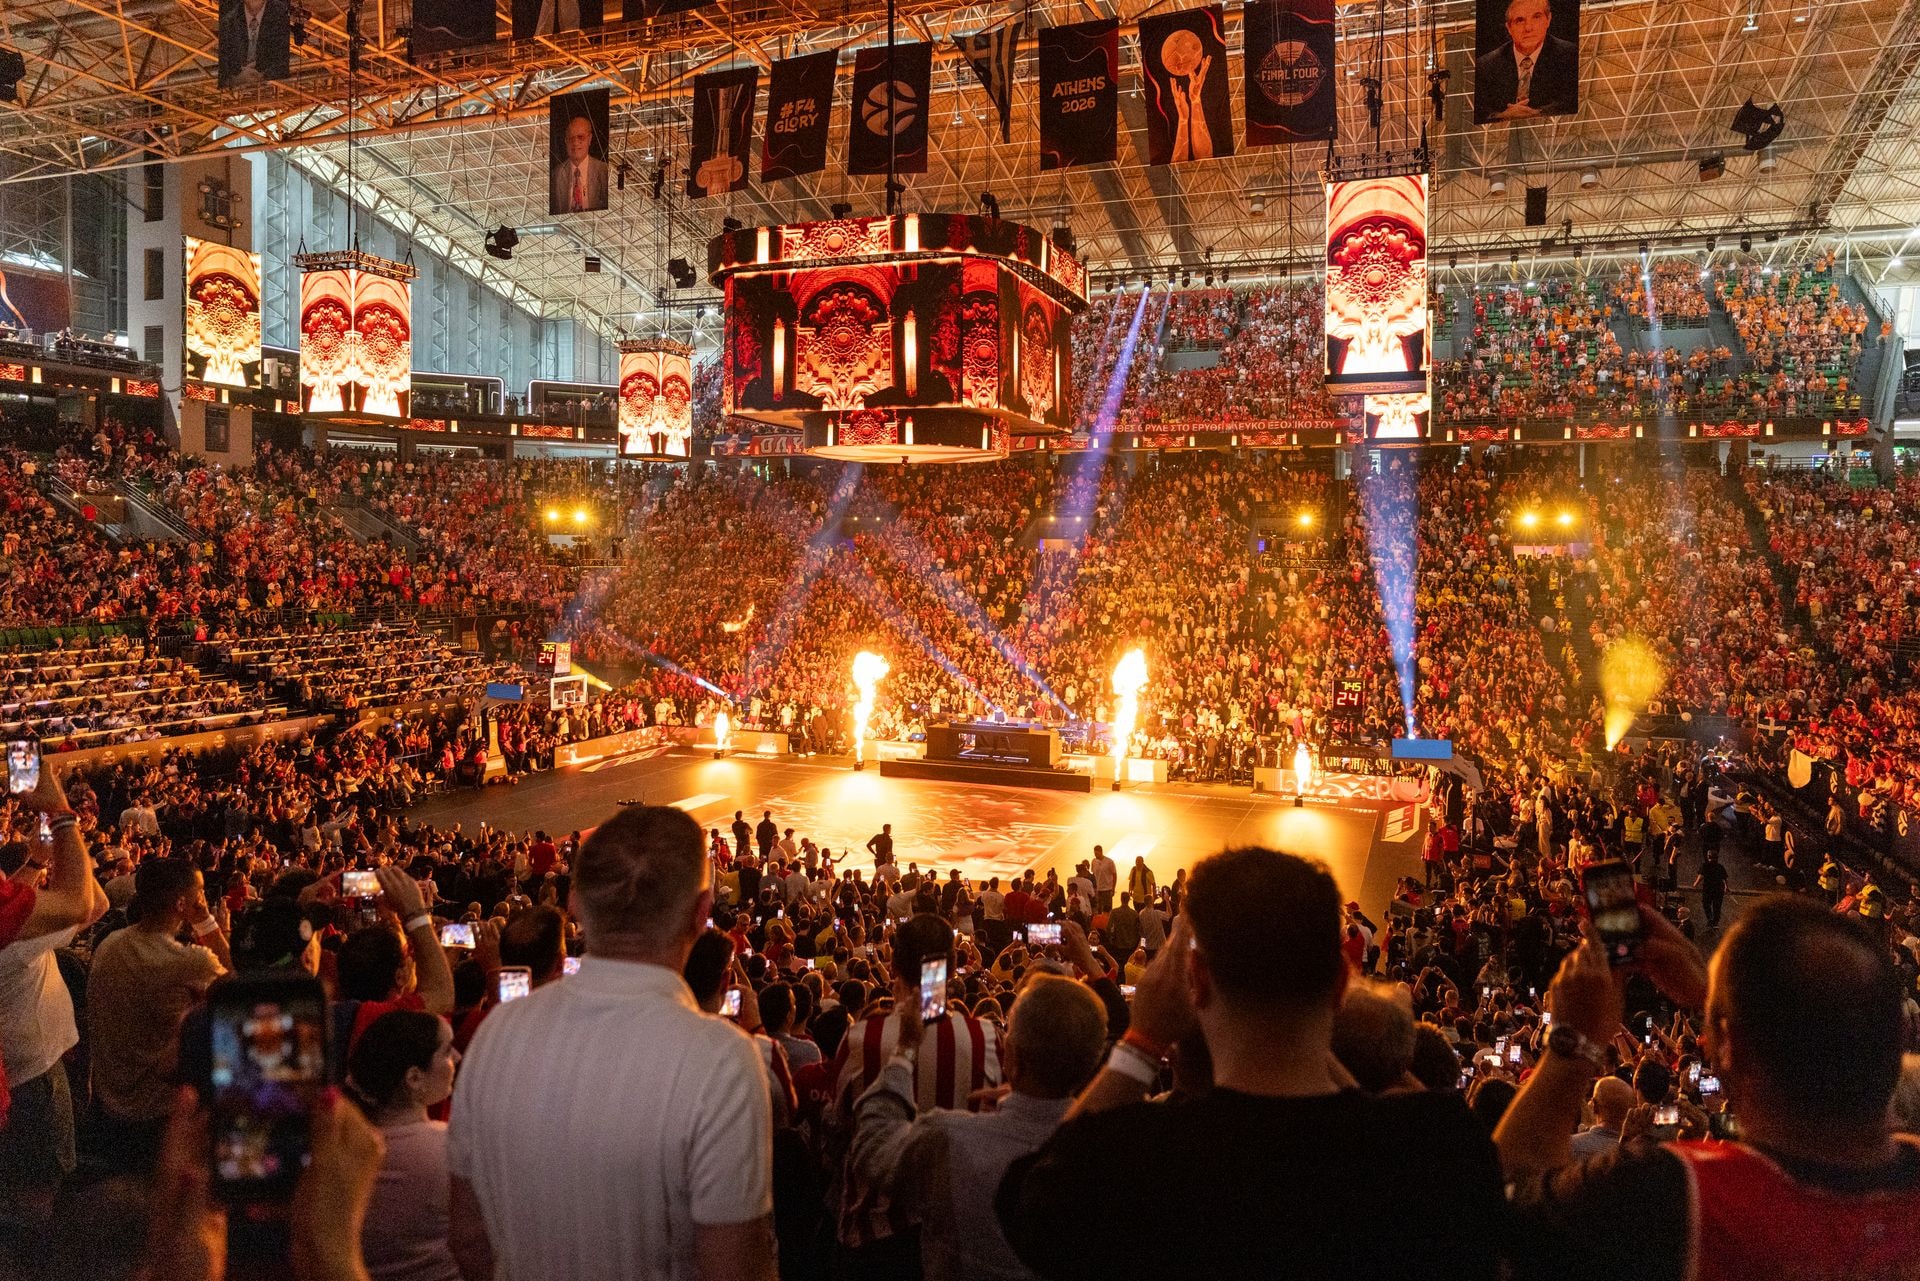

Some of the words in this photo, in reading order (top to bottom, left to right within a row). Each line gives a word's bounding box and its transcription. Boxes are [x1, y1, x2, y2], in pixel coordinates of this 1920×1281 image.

[1261, 69, 1291, 81] FINAL
[1293, 67, 1319, 79] FOUR
[1052, 76, 1106, 98] ATHENS
[779, 97, 816, 119] #F4
[1061, 96, 1097, 114] 2026
[774, 112, 819, 134] GLORY
[1103, 424, 1136, 433] ΗΡΘΕΣ
[1171, 423, 1190, 432] ΣΤΟ
[1314, 420, 1335, 429] ΣΟΥ
[538, 652, 553, 664] 24
[1336, 691, 1359, 706] 24
